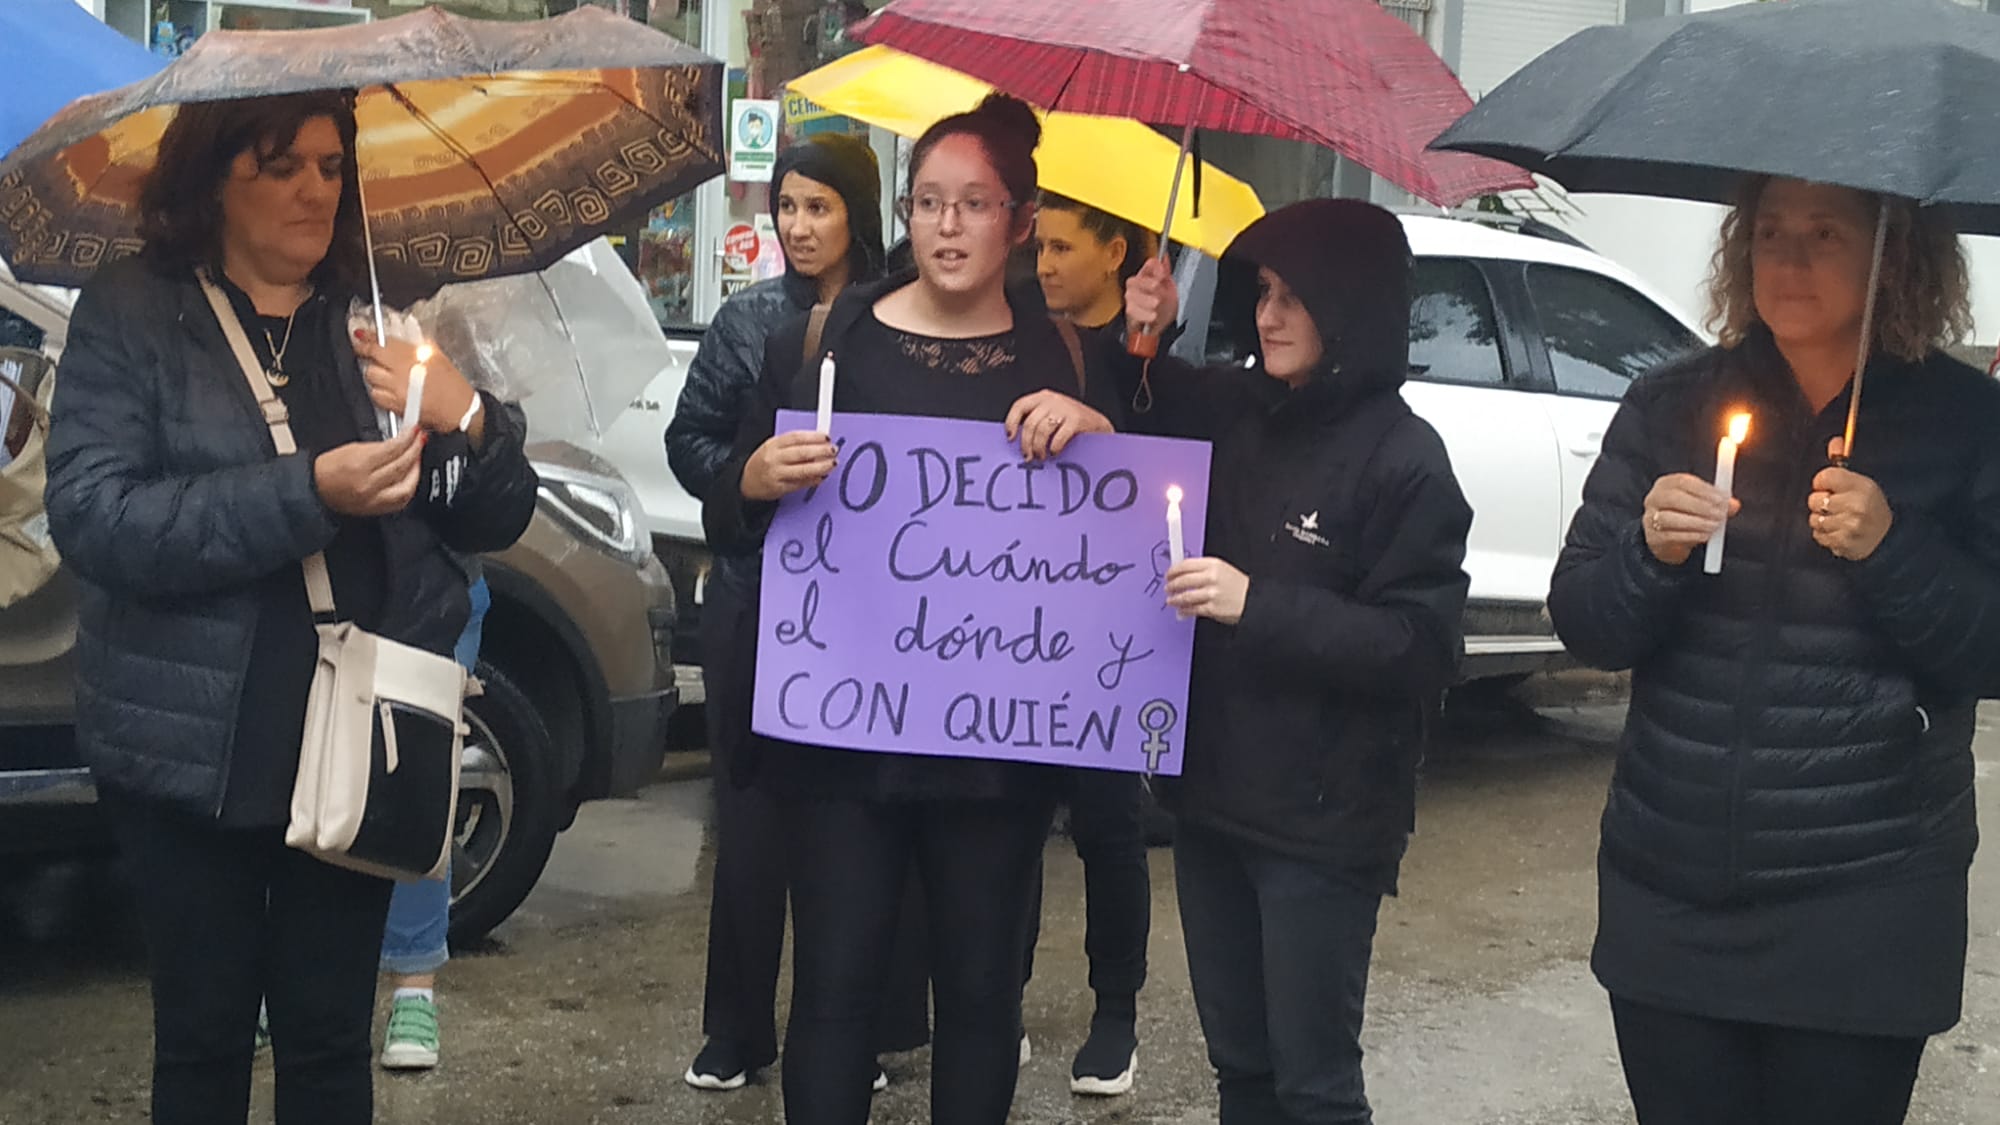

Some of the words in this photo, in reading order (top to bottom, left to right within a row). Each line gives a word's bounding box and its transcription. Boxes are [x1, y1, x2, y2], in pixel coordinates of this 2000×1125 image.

[907, 447, 1138, 516] DECIDO
[780, 512, 840, 574] el
[888, 519, 1135, 585] Cuándo
[775, 579, 826, 649] el
[894, 596, 1074, 663] dónde
[1097, 631, 1154, 690] y
[778, 671, 909, 736] CON
[944, 691, 1121, 752] QUIÉN
